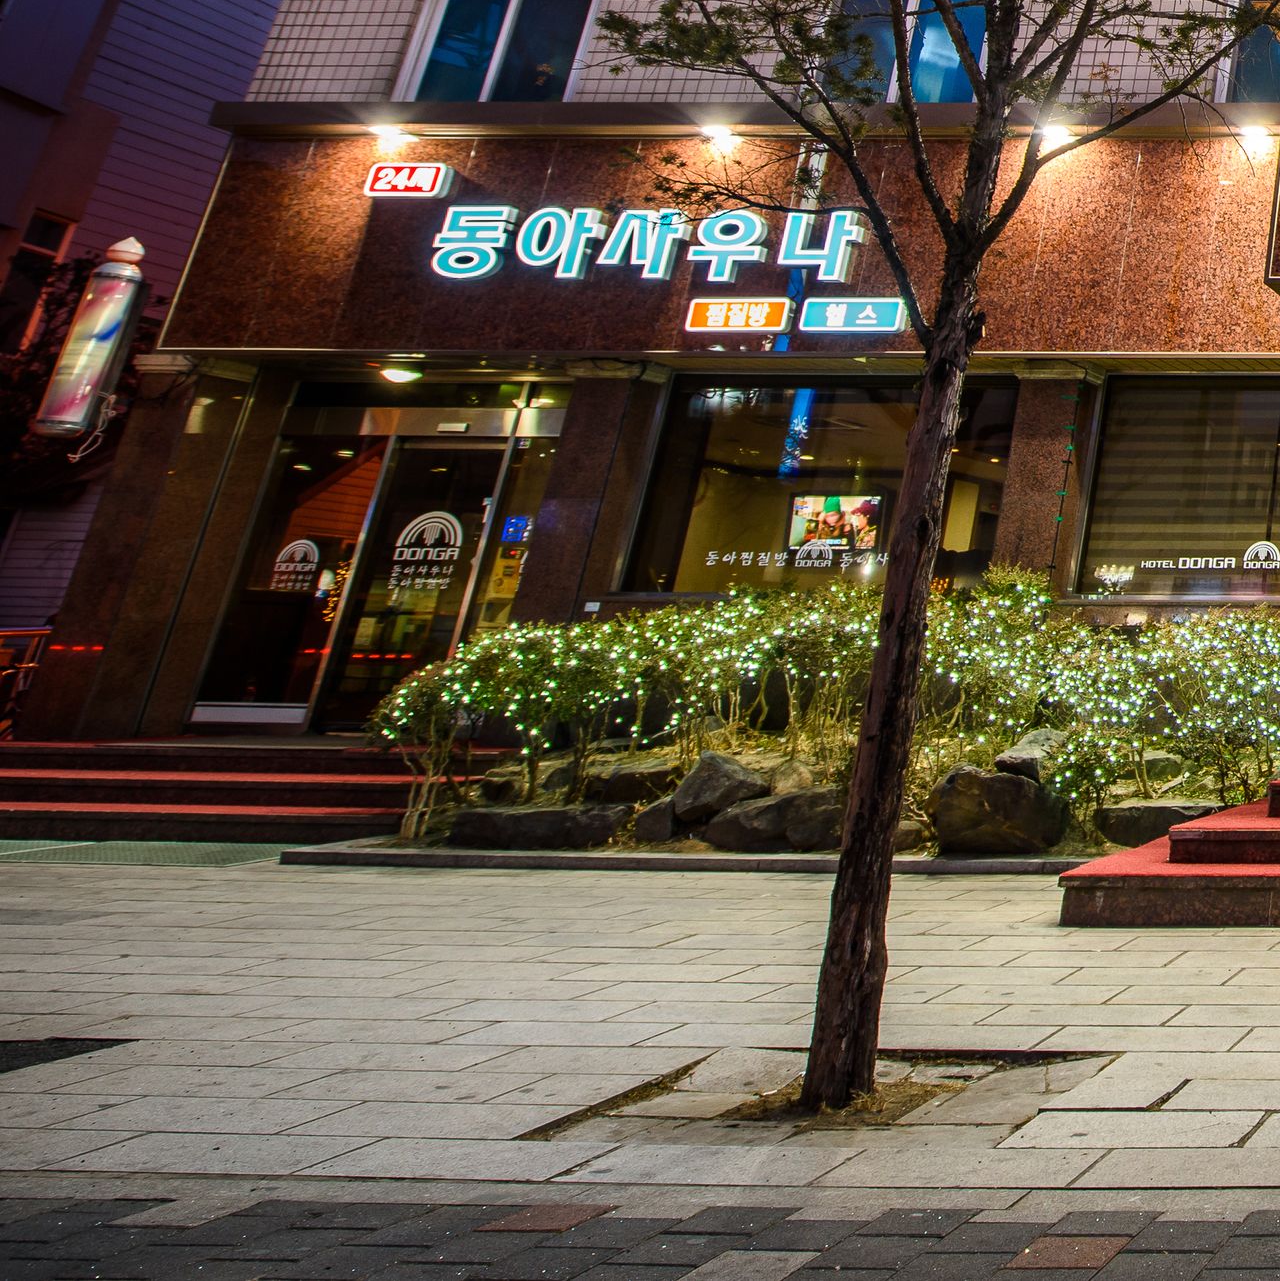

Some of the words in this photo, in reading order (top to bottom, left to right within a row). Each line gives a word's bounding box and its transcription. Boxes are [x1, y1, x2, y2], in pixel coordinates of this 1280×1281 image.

[432, 205, 866, 283] 동아사우나
[706, 303, 770, 327] 찜질방
[393, 547, 460, 561] DONGA
[705, 550, 789, 567] 동아찜질방
[795, 560, 831, 568] DONGA
[1141, 560, 1176, 569] HOTEL
[1178, 557, 1236, 569] DONGA
[1243, 561, 1280, 569] DONGA
